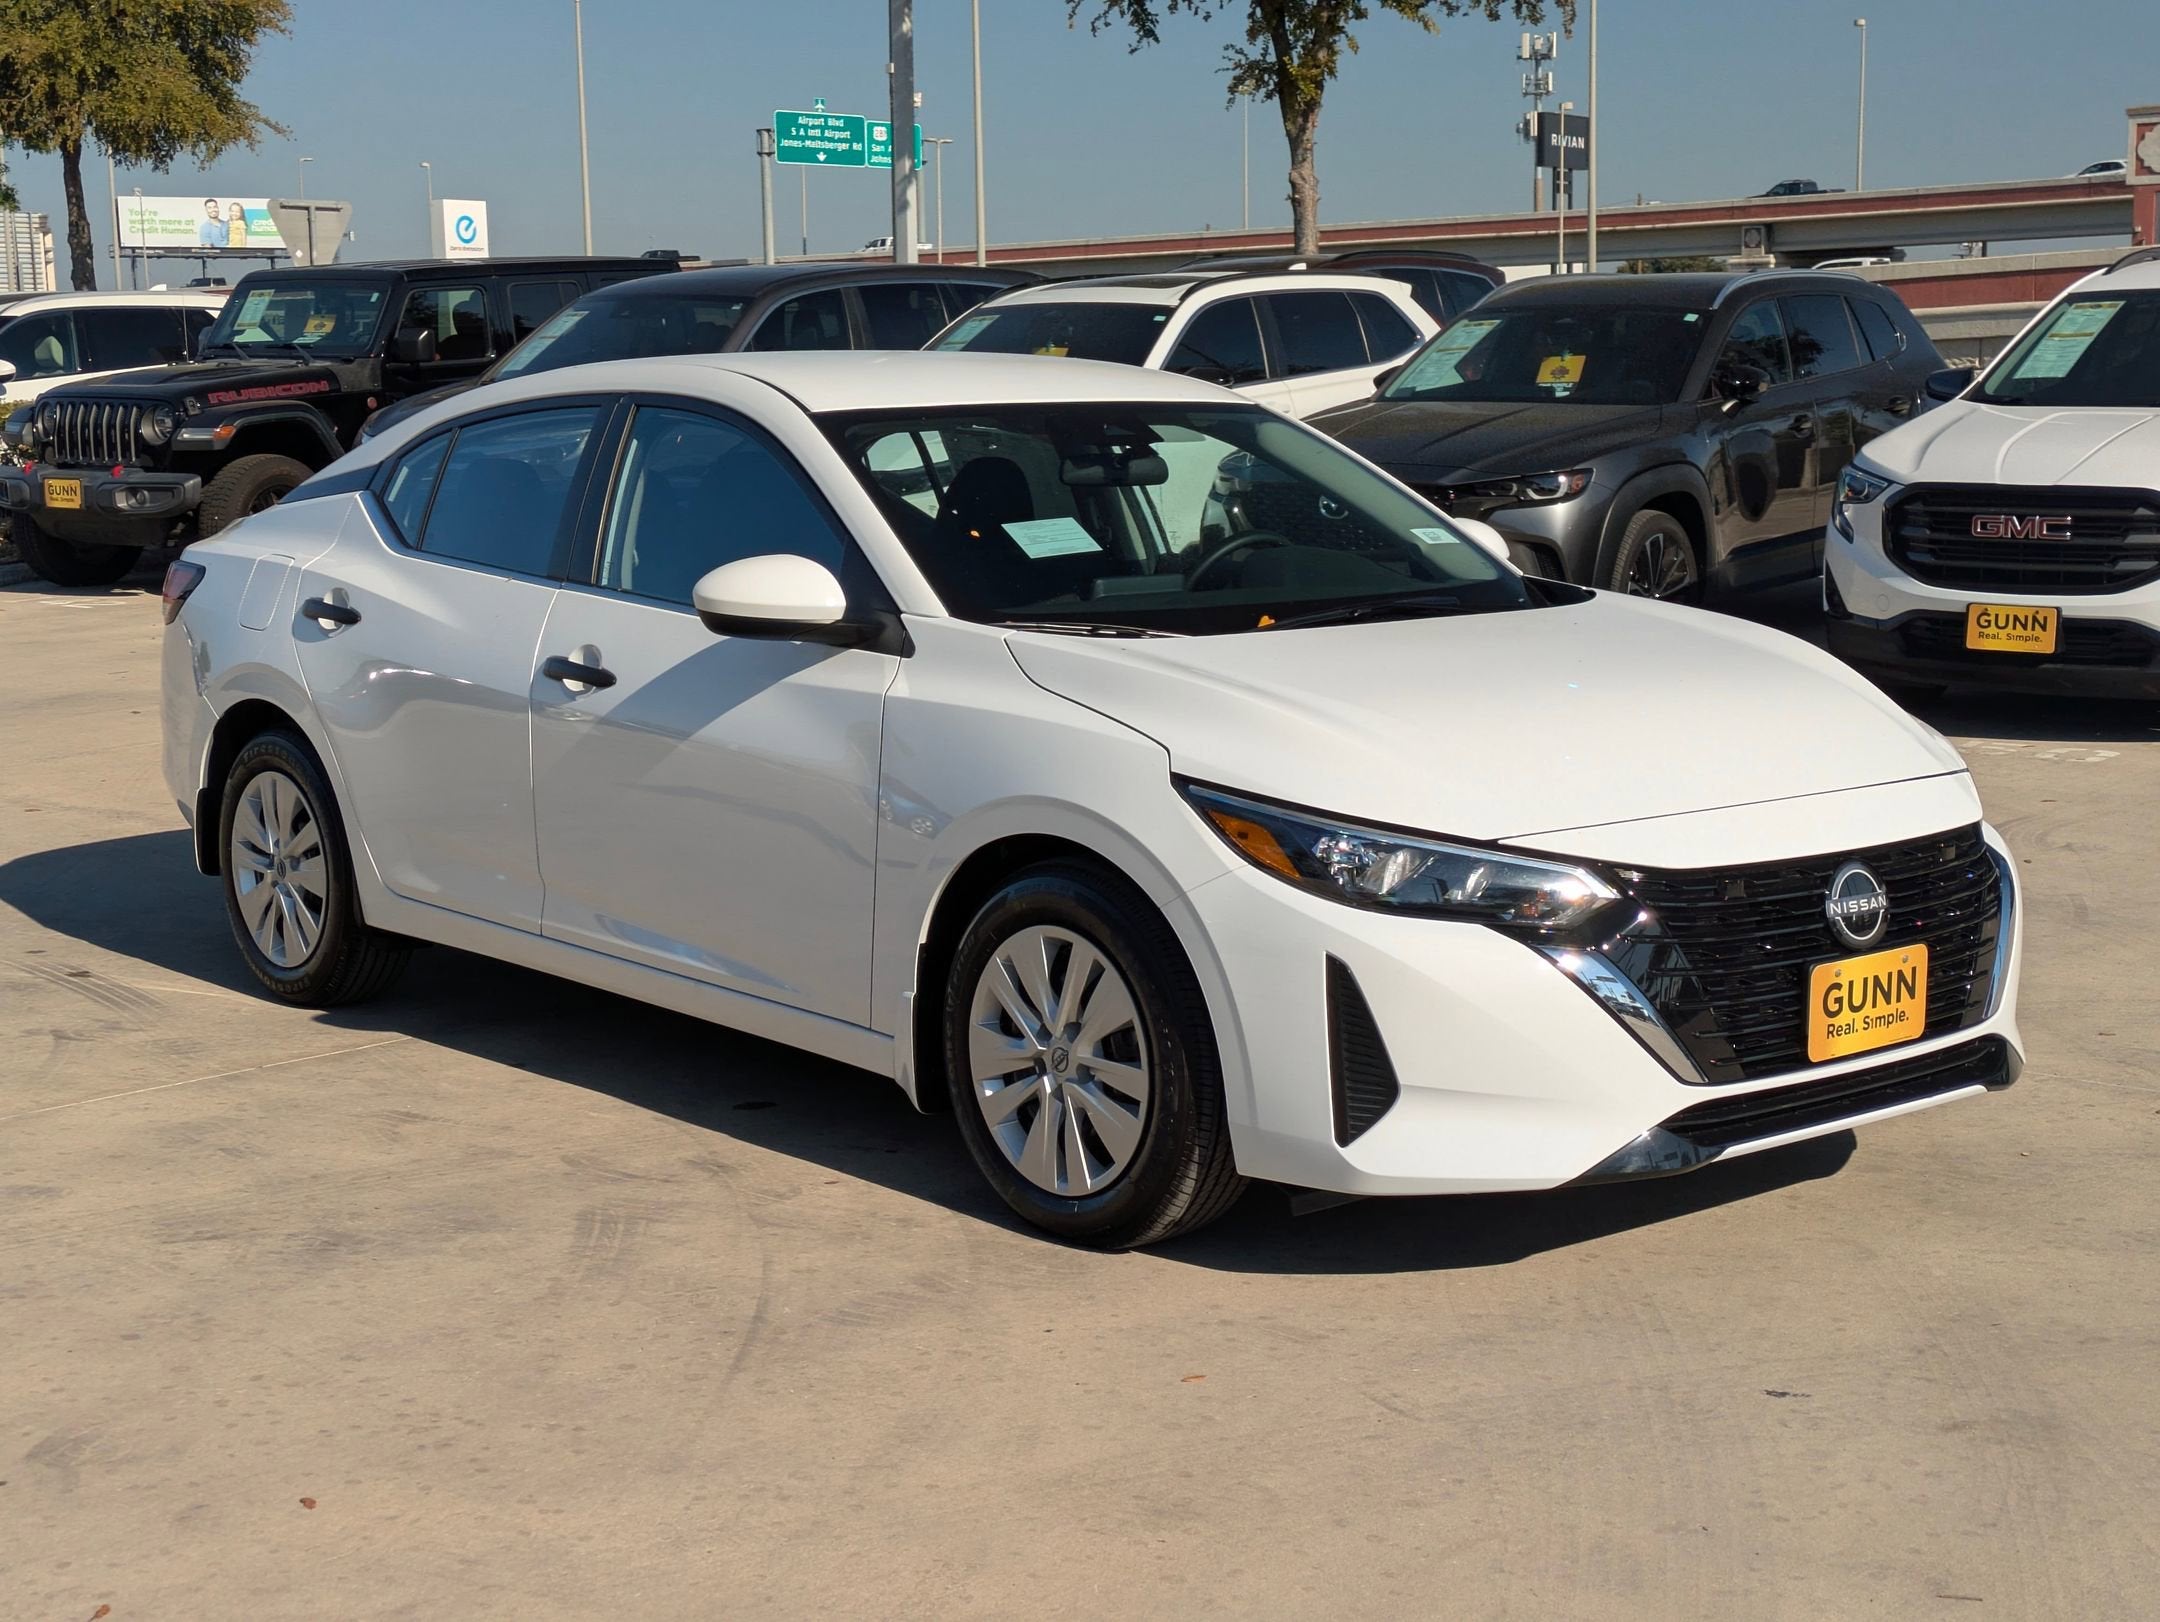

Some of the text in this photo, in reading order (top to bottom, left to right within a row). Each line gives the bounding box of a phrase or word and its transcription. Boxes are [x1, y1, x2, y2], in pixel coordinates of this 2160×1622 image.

[798, 116, 844, 127] Airport Blvd
[791, 127, 797, 136] S
[799, 127, 805, 136] A
[824, 129, 851, 140] Airport
[853, 142, 863, 151] Rd
[871, 143, 886, 152] San
[1551, 133, 1585, 149] RIVIAN
[159, 218, 183, 226] more
[184, 218, 195, 226] at
[208, 381, 329, 404] RUBICON
[48, 485, 77, 496] GUNN
[1972, 515, 2071, 540] GMC
[1976, 612, 2048, 632] GUNN
[1978, 631, 2002, 641] Real.
[1830, 894, 1887, 914] NISSAN
[1823, 966, 1917, 1019] GUNN
[1827, 1018, 1858, 1039] Real.
